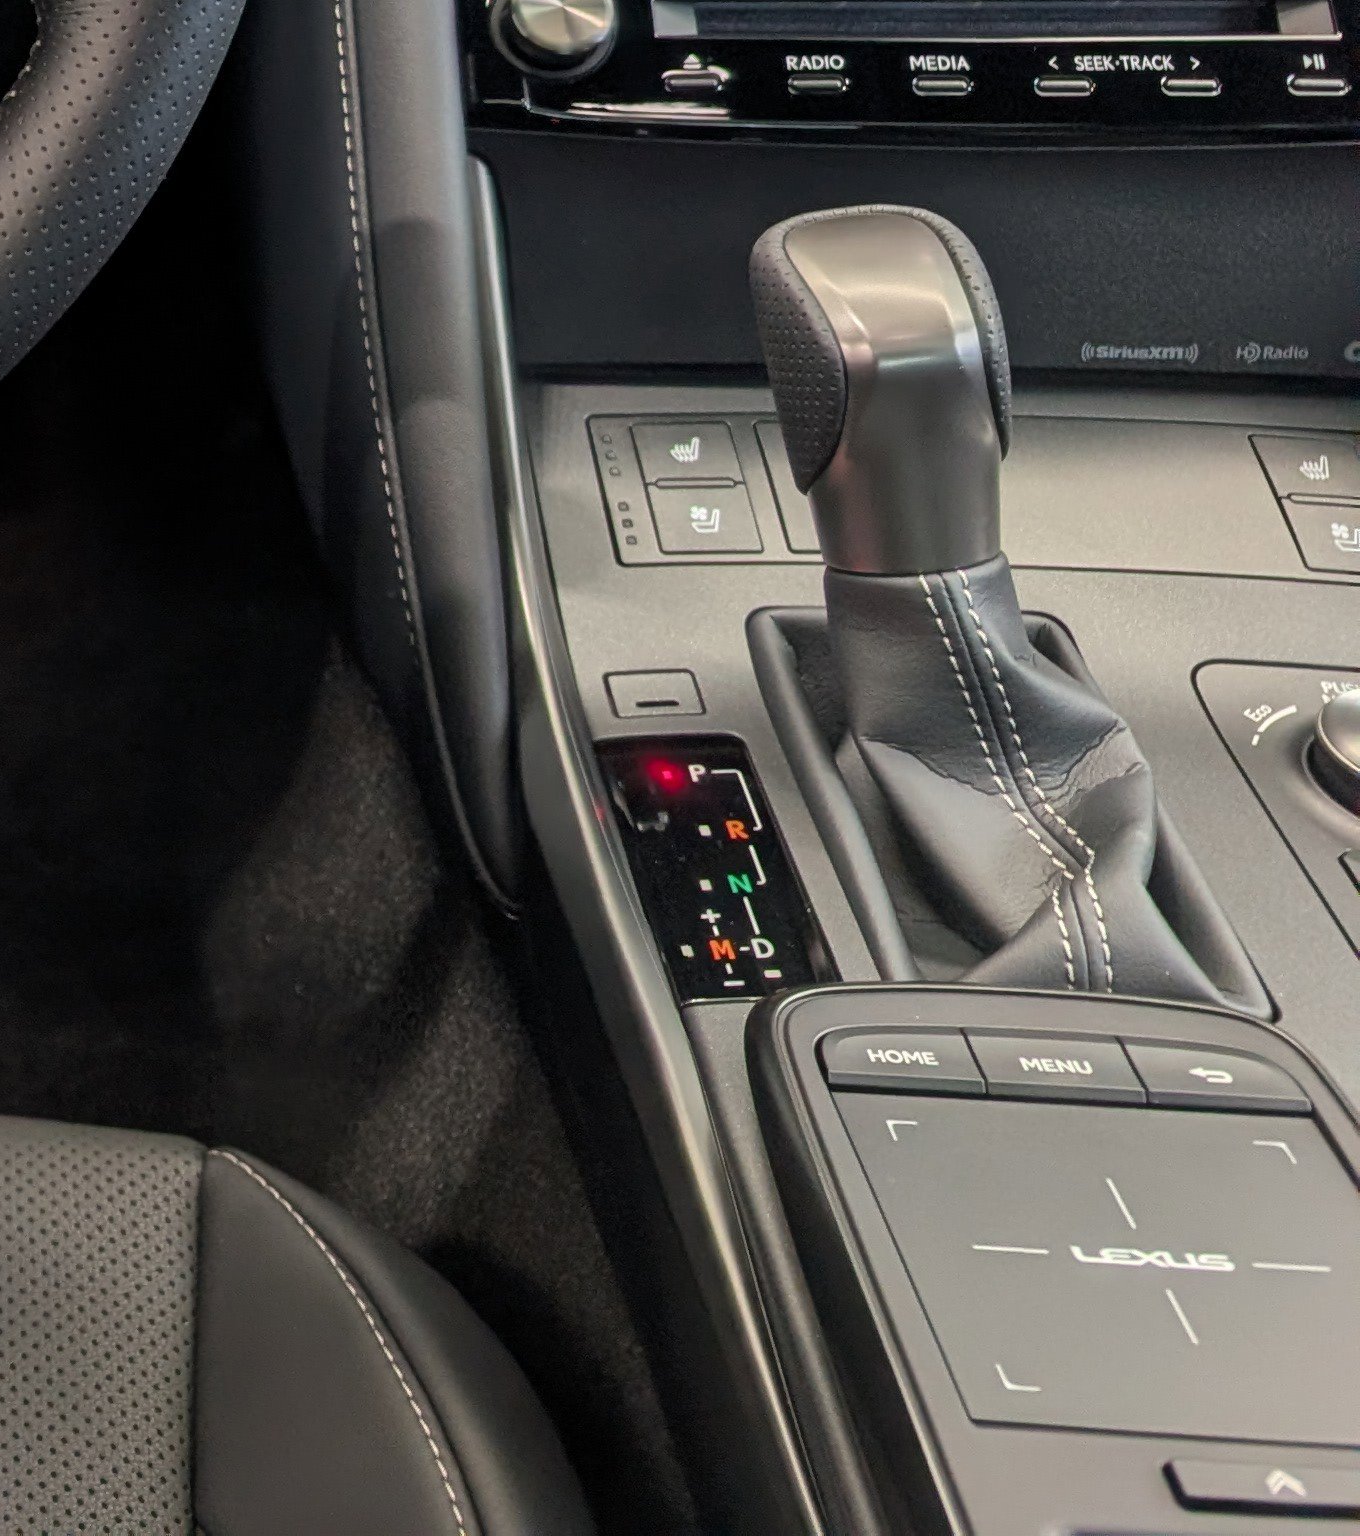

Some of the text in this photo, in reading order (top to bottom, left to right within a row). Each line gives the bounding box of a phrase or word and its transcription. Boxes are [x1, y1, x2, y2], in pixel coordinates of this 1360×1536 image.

[785, 54, 845, 71] RADIO
[909, 54, 971, 72] MEDIA
[1262, 345, 1309, 360] Radio
[1243, 704, 1272, 723] Eco
[687, 763, 706, 783] P
[725, 819, 750, 840] R
[727, 873, 753, 894] N
[709, 939, 737, 961] M
[750, 937, 775, 959] D
[866, 1047, 940, 1067] HOME
[1019, 1057, 1093, 1076] MENU
[1071, 1245, 1236, 1272] LEXUS
